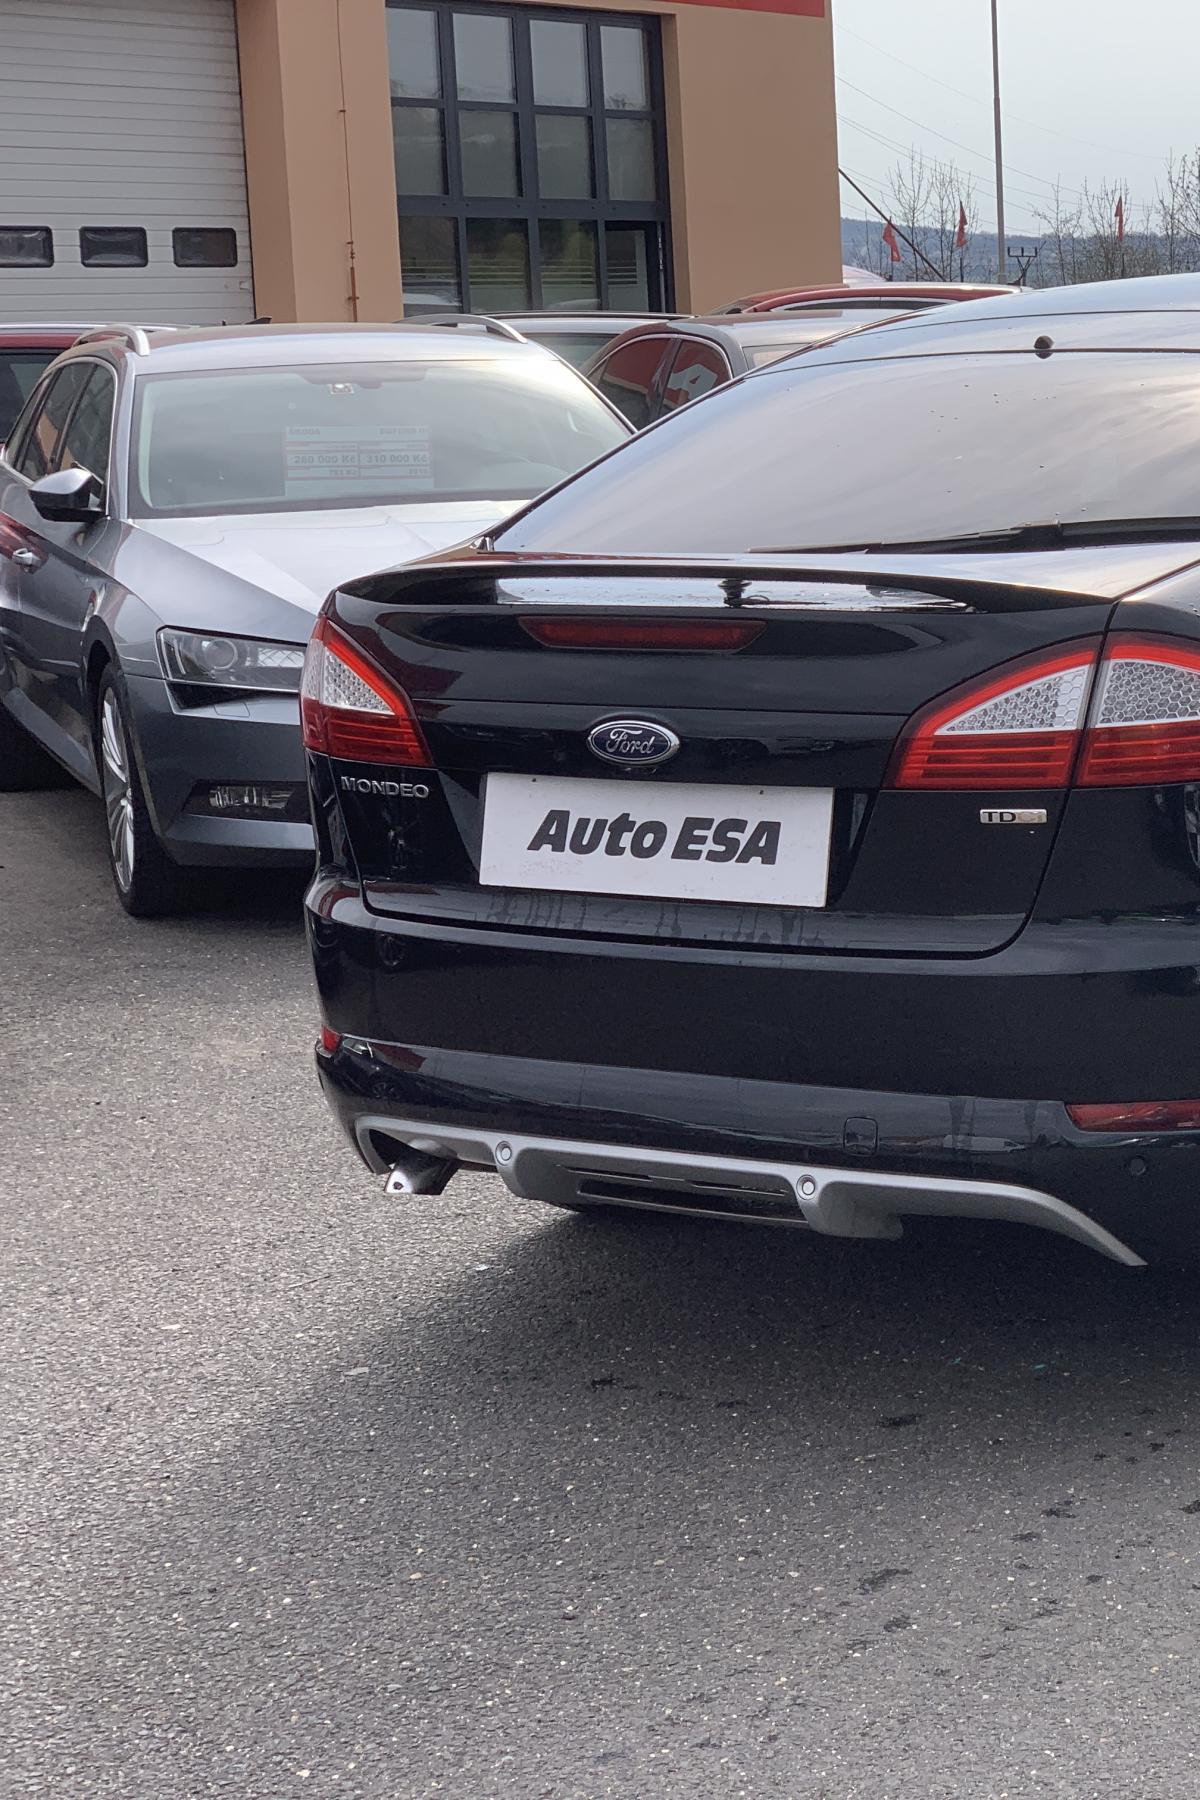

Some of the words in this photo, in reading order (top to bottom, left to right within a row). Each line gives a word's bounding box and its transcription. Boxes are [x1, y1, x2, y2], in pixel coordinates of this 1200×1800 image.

[606, 729, 655, 755] Ford
[340, 775, 430, 798] MONDEO
[527, 809, 668, 859] Auto
[670, 816, 782, 866] ESA
